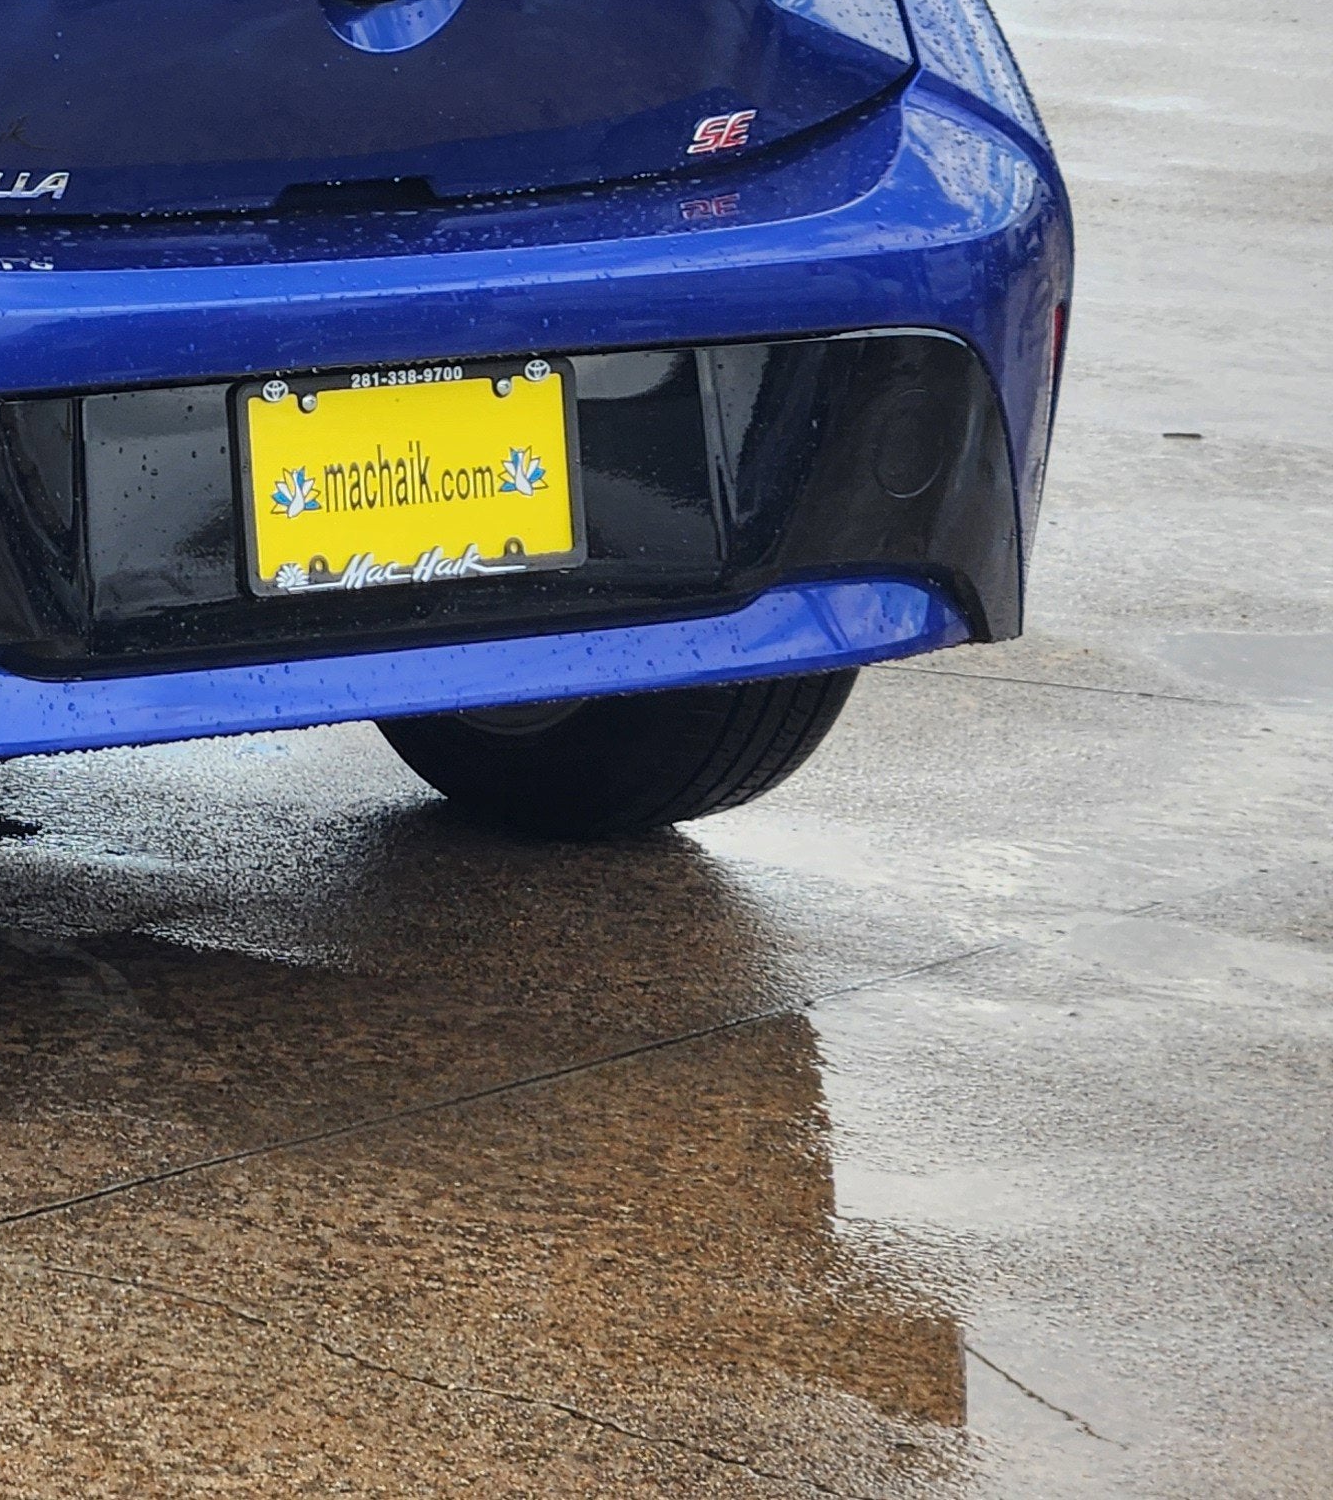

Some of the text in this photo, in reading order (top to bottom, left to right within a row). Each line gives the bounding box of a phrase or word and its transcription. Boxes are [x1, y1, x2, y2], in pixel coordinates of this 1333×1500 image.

[686, 109, 758, 154] SE
[350, 365, 463, 389] 281-338-9700
[323, 440, 495, 513] machaik.com
[342, 543, 505, 590] Mac Haik
